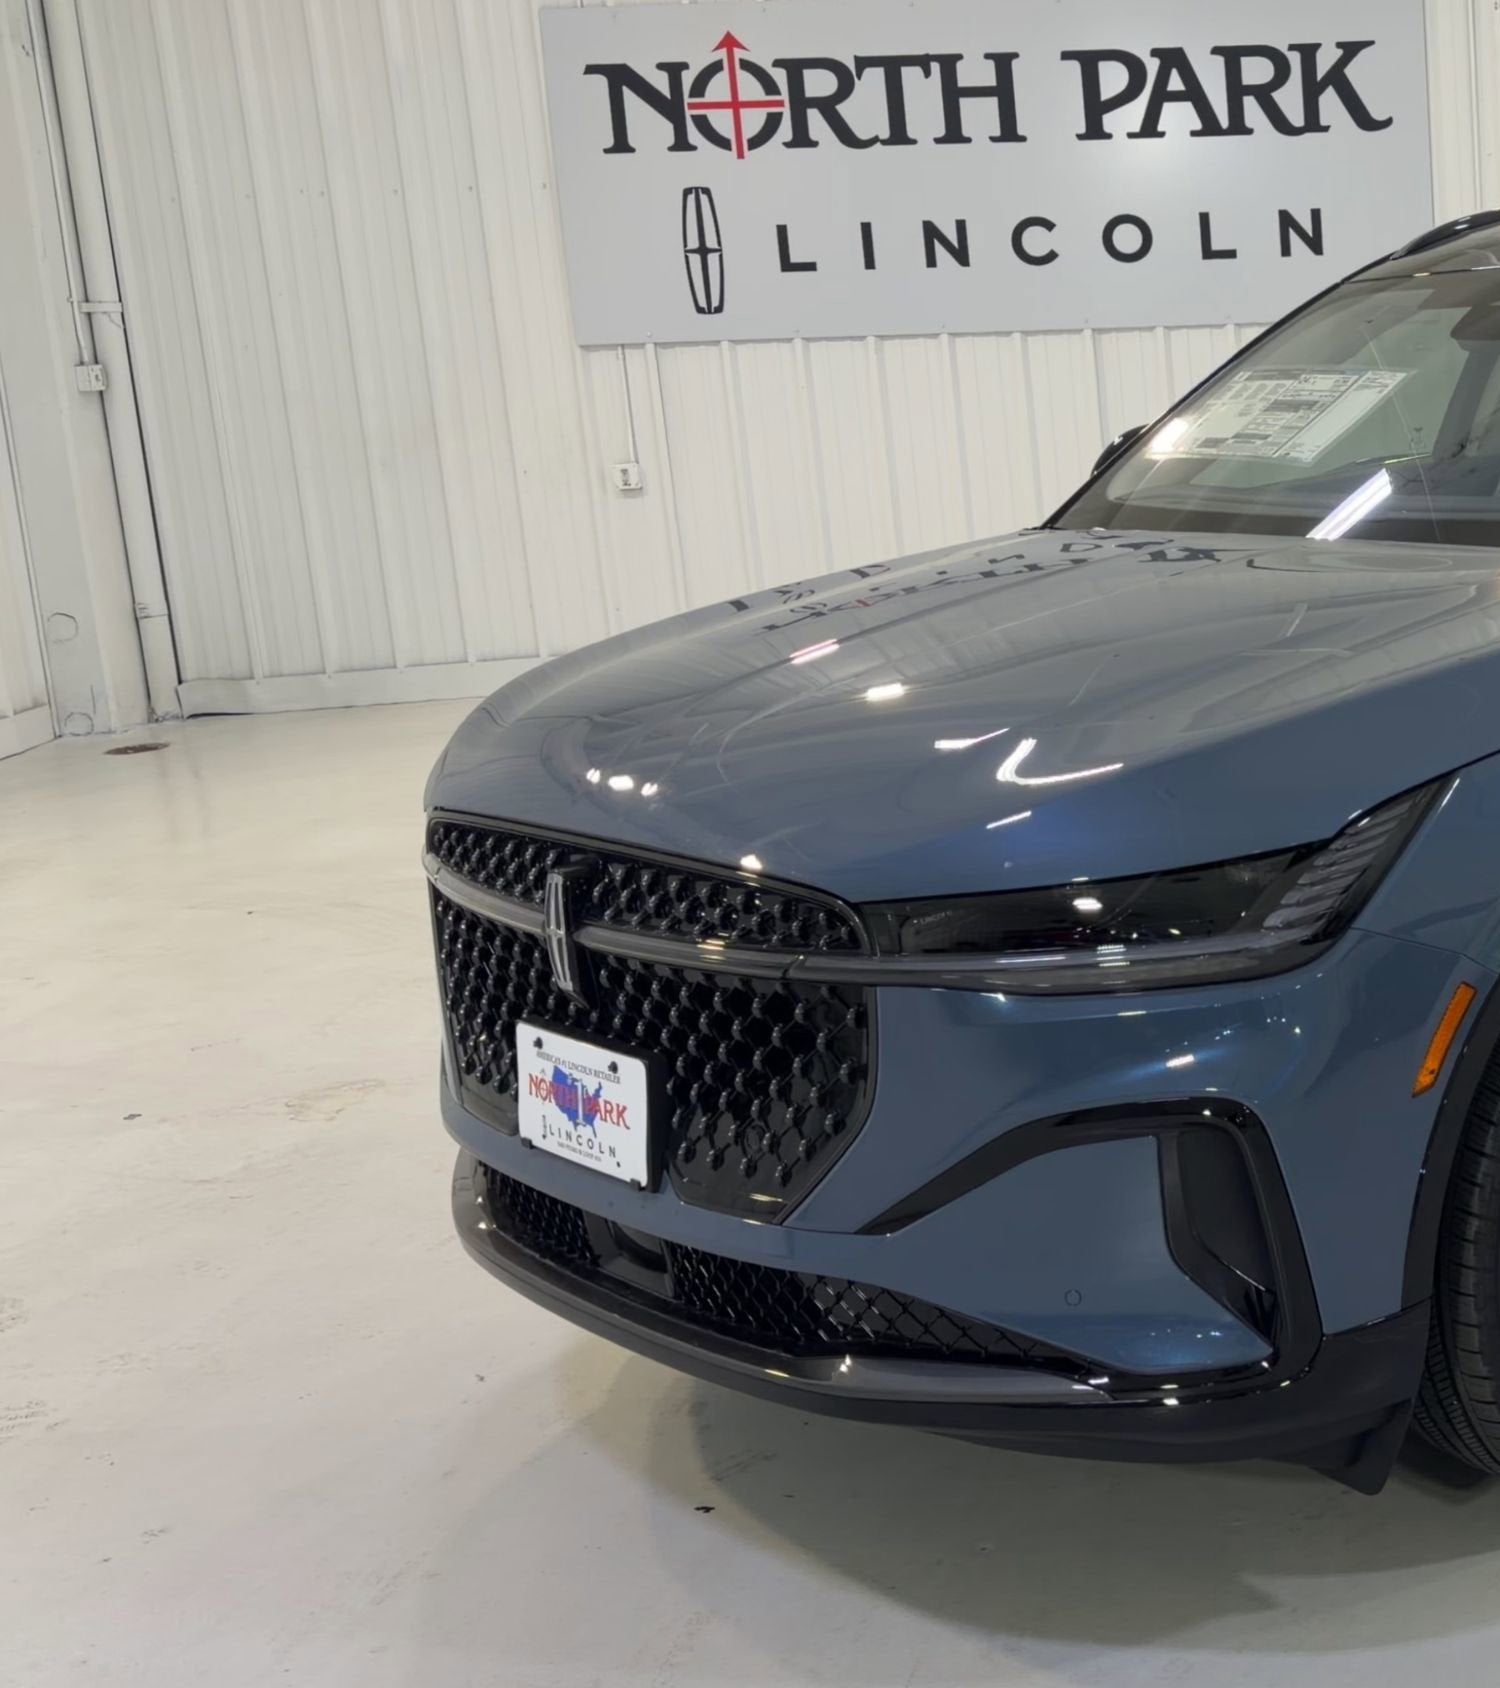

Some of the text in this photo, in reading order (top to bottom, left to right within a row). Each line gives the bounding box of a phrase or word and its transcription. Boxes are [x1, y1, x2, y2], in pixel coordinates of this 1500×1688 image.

[583, 40, 1394, 156] NORTH PARK
[775, 208, 1325, 274] LINCOLN
[528, 1073, 577, 1112] NORTH
[583, 1090, 631, 1130] PARK
[549, 1124, 617, 1158] LINCOLN
